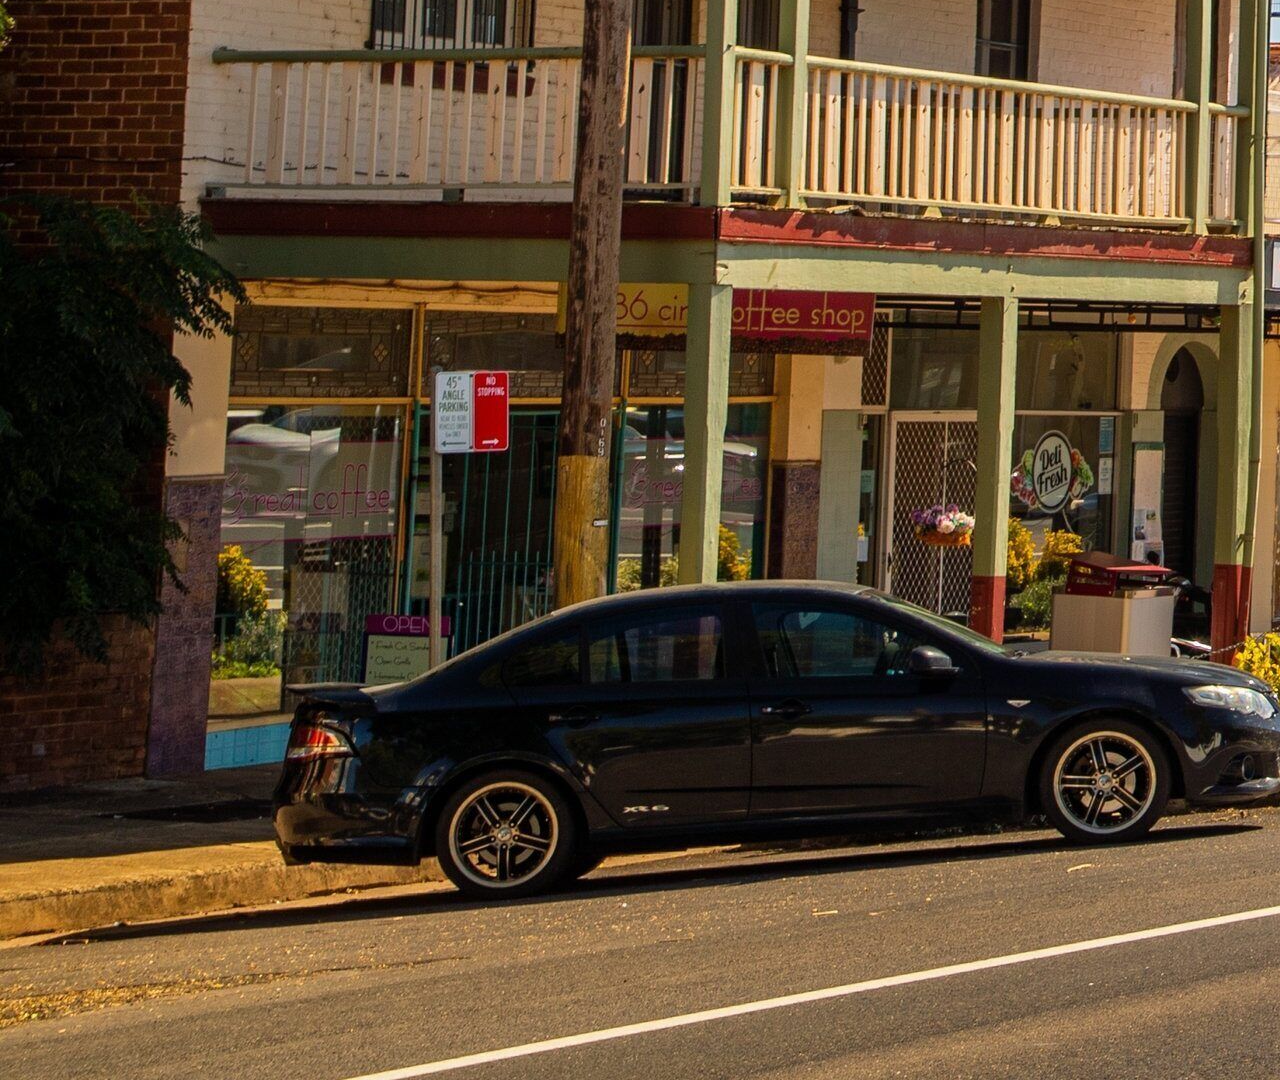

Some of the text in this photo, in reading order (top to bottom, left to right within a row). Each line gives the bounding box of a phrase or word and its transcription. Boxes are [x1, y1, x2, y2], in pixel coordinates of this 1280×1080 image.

[732, 288, 800, 332] offee
[811, 291, 865, 335] shop
[486, 376, 496, 385] NO
[442, 390, 465, 400] ANGLE
[477, 387, 505, 397] STOPPING
[439, 402, 468, 412] PARKING
[1040, 444, 1062, 470] Deli
[652, 479, 684, 498] rea
[1037, 463, 1068, 495] Fresh
[252, 463, 390, 519] real coffee
